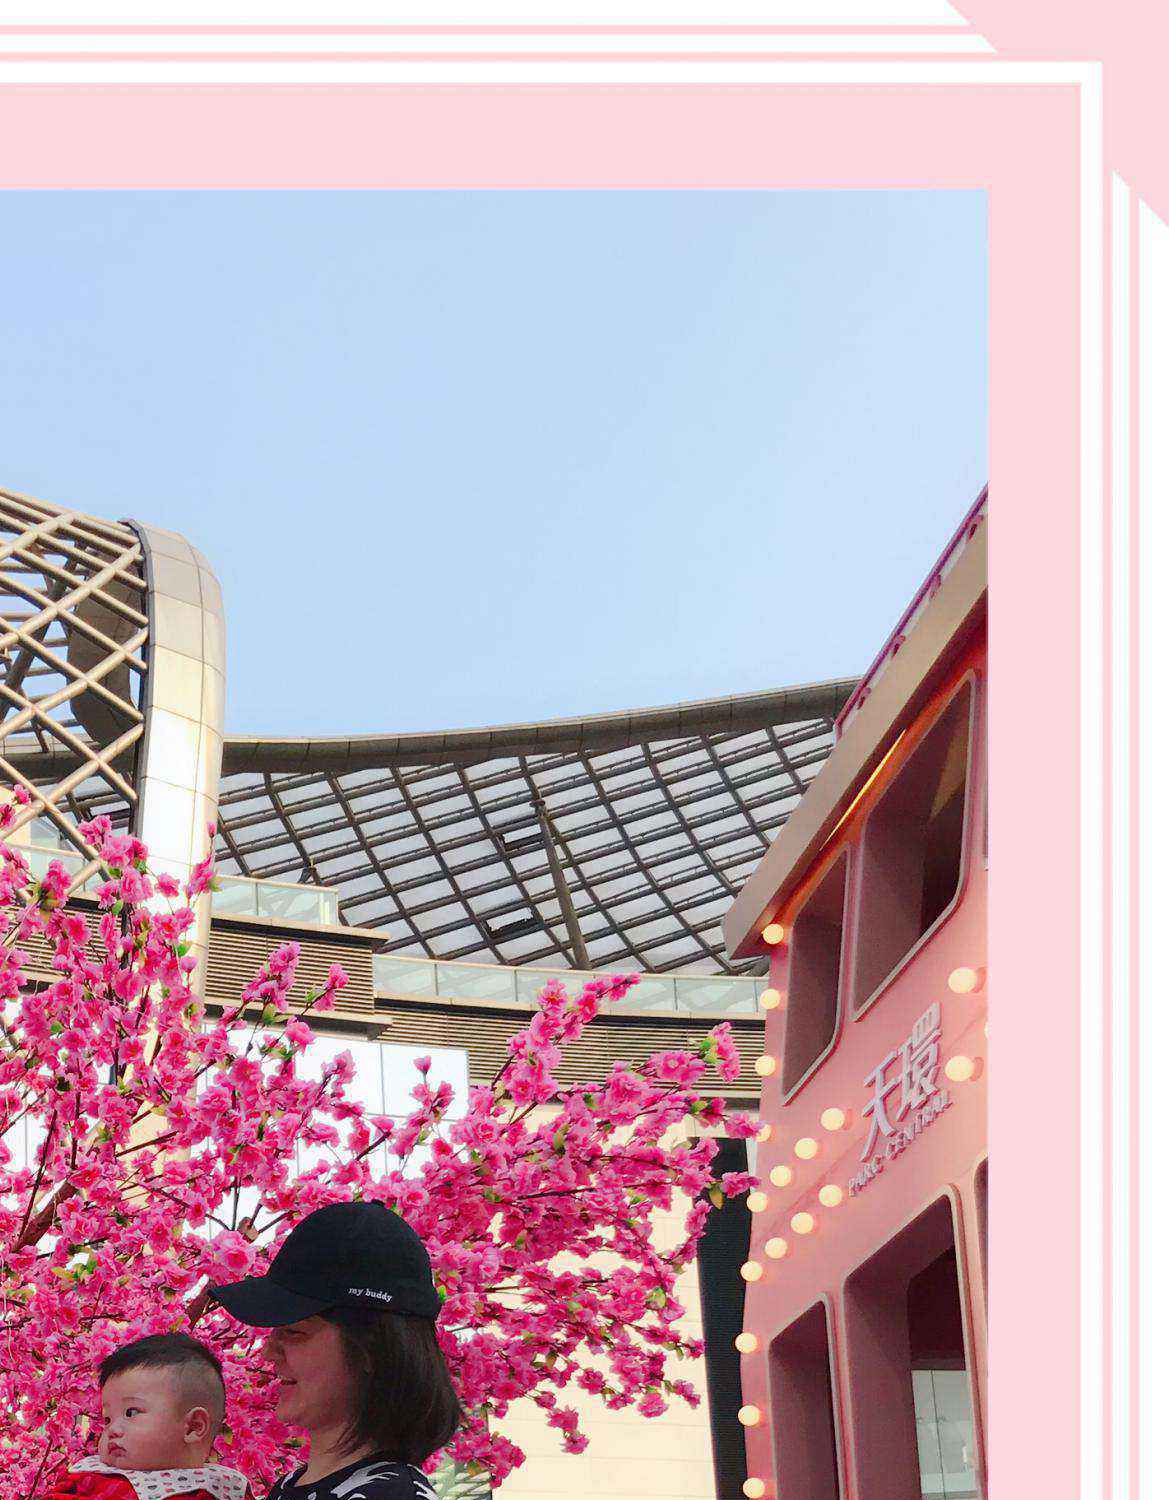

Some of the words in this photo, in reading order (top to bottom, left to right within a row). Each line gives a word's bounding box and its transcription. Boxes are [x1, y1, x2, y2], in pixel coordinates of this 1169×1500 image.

[861, 1002, 942, 1163] 天環
[348, 1287, 364, 1297] my
[365, 1288, 393, 1303] buddy
